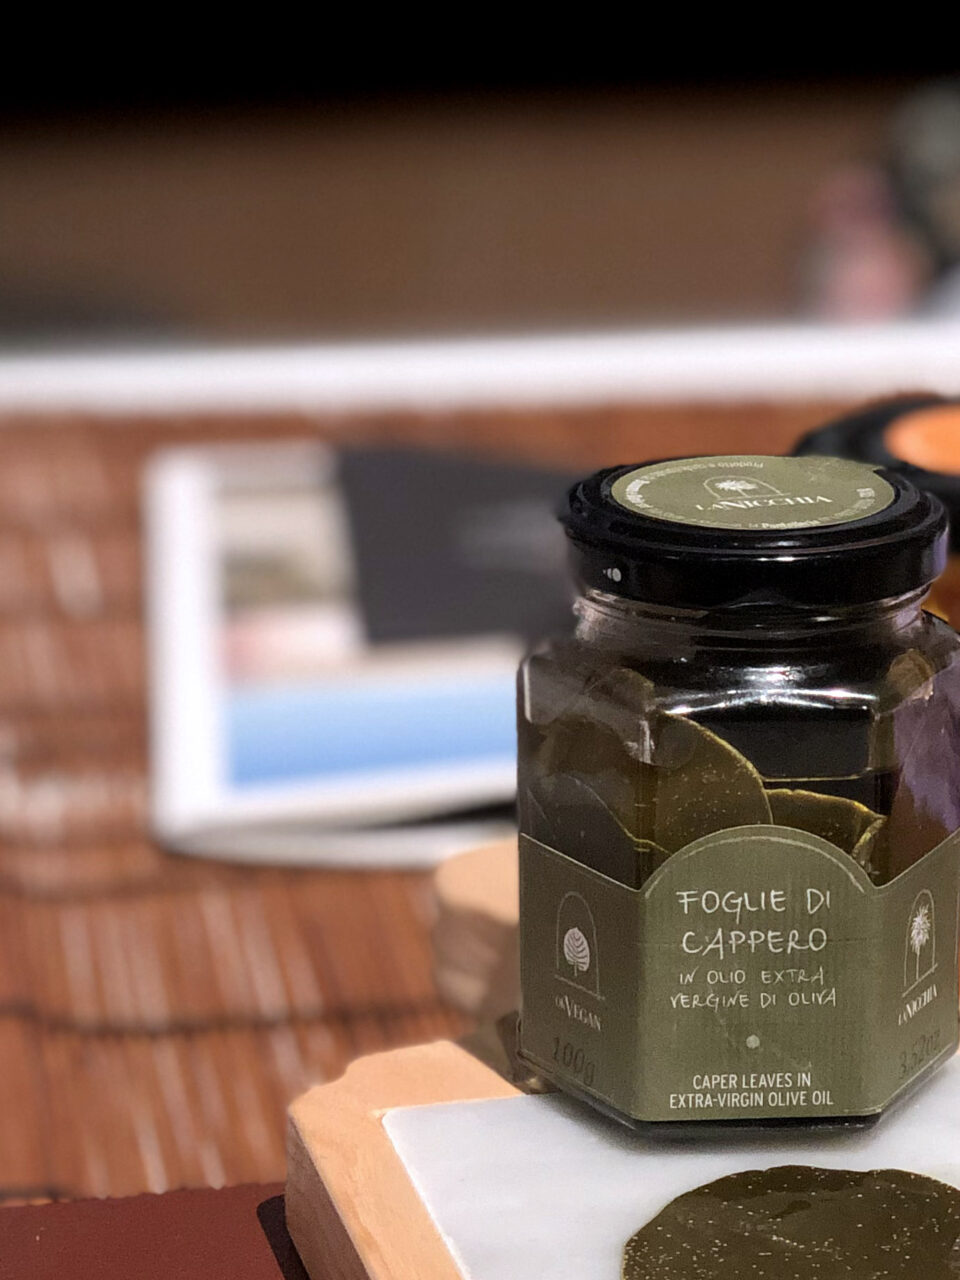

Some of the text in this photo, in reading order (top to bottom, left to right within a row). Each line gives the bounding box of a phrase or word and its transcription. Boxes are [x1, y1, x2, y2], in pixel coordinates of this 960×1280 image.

[675, 888, 830, 924] FOGLIE DI
[682, 928, 827, 960] CAPPERO
[679, 966, 824, 985] IN OLIO EXTRA
[670, 987, 837, 1013] VERGINE DI OLIVA
[692, 1072, 811, 1091] CAPER LEAVES IN
[669, 1090, 834, 1109] EXTRA-VIRGIN OLIVE OIL
